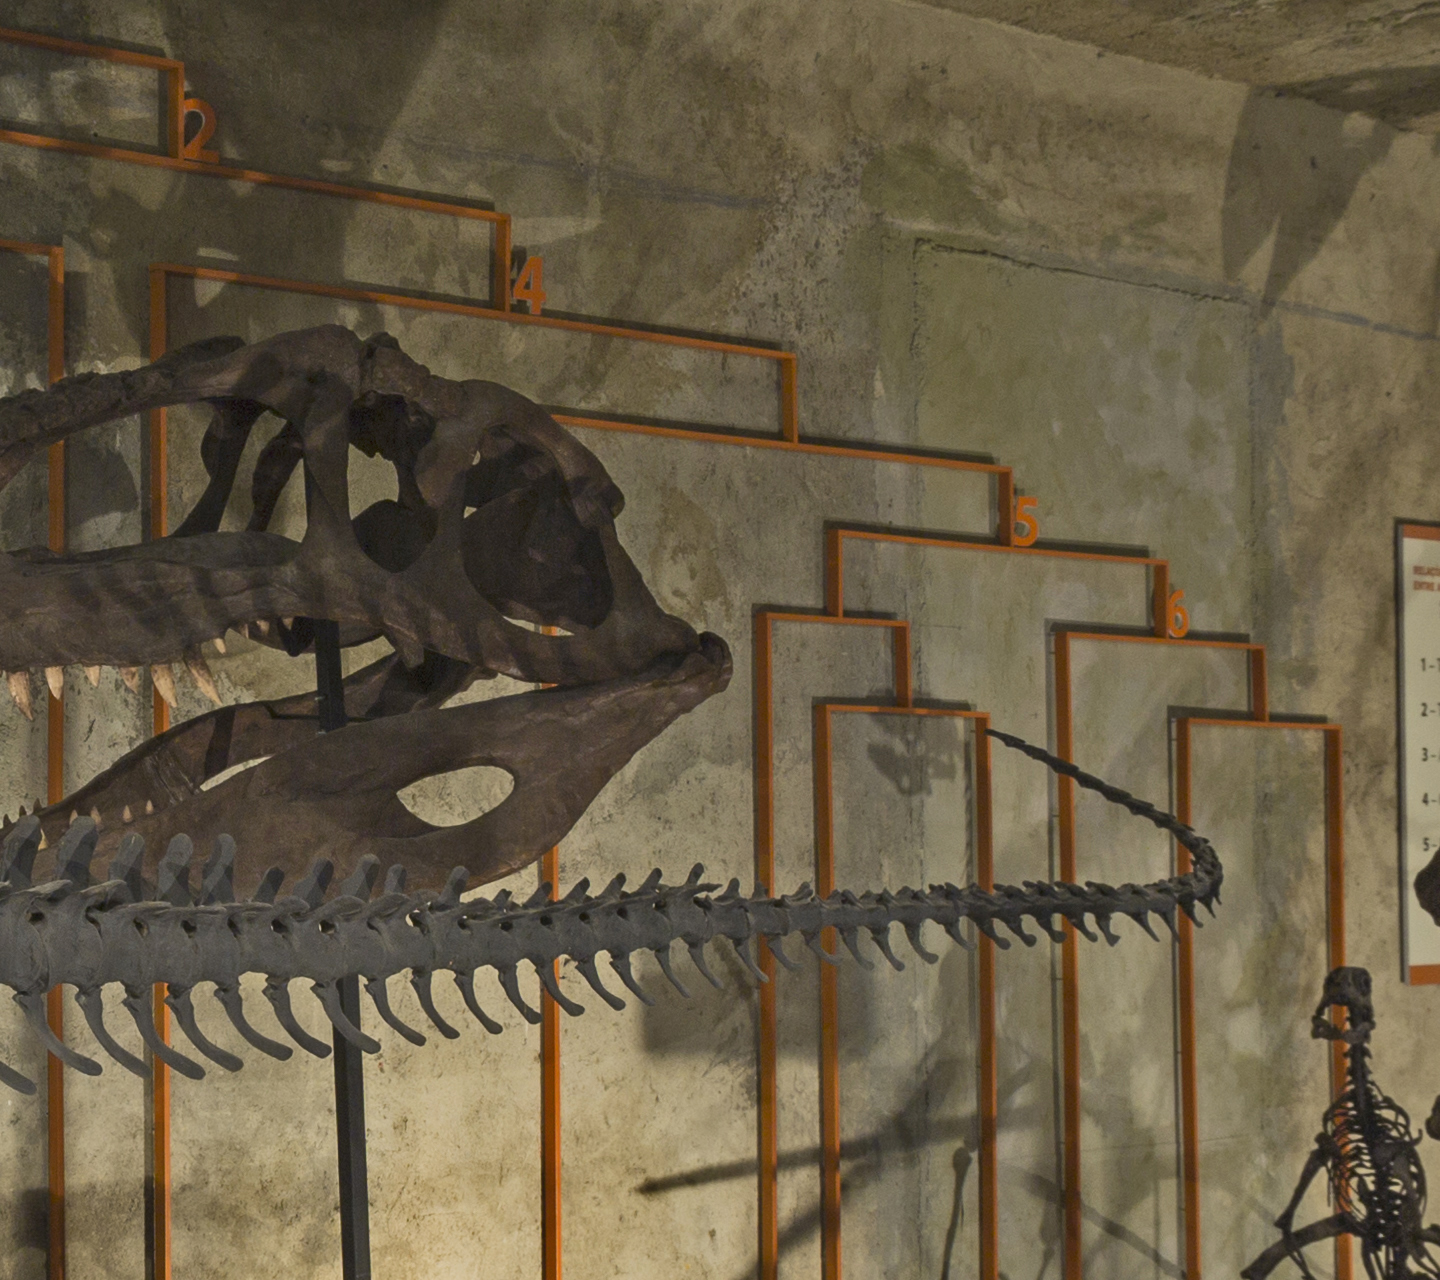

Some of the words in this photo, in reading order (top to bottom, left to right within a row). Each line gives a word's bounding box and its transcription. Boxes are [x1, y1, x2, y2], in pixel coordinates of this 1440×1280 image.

[1421, 702, 1428, 717] 2
[1422, 747, 1428, 762] 3
[1422, 792, 1429, 806] 4
[1423, 837, 1430, 852] 5
